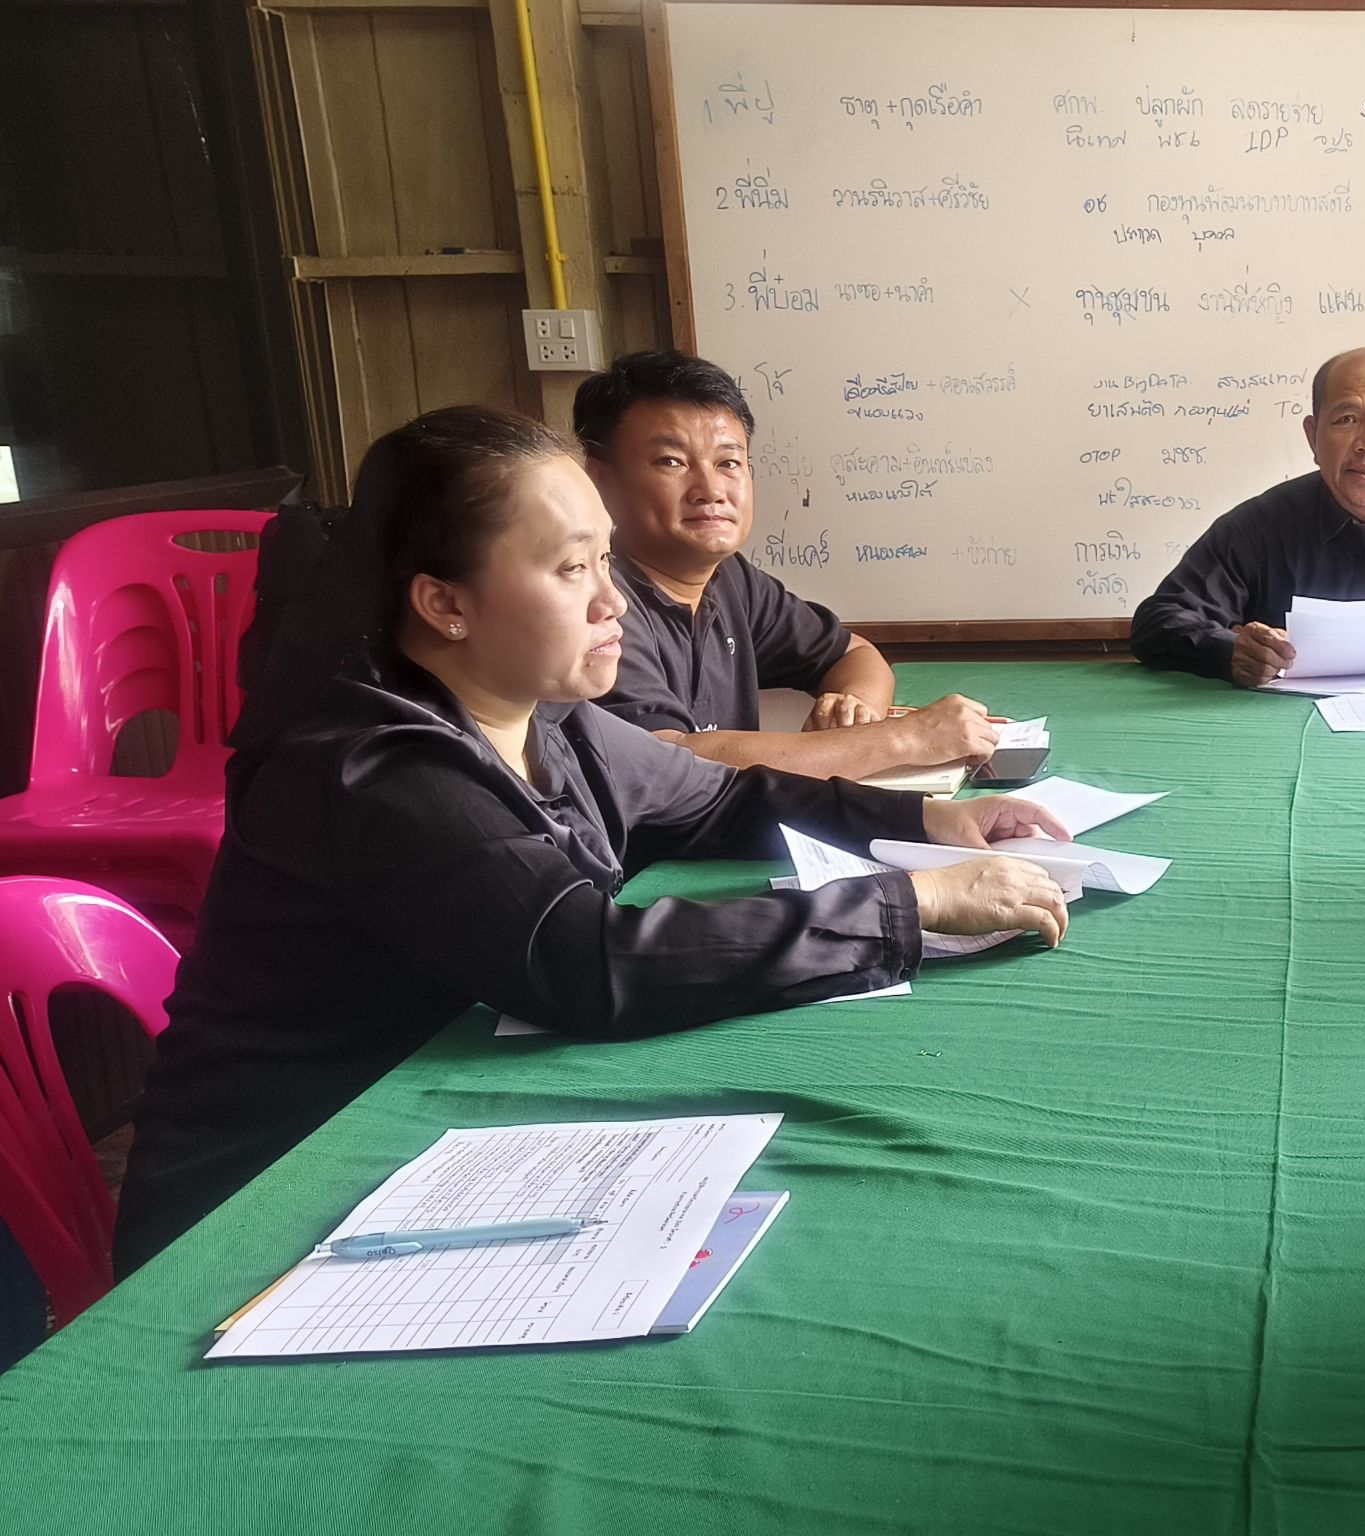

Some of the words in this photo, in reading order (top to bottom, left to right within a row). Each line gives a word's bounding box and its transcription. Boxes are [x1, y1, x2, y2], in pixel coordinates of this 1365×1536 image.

[1136, 84, 1204, 128] ปลูกผัก
[1074, 530, 1142, 562] การเงิน
[1076, 570, 1130, 609] พัสดุ
